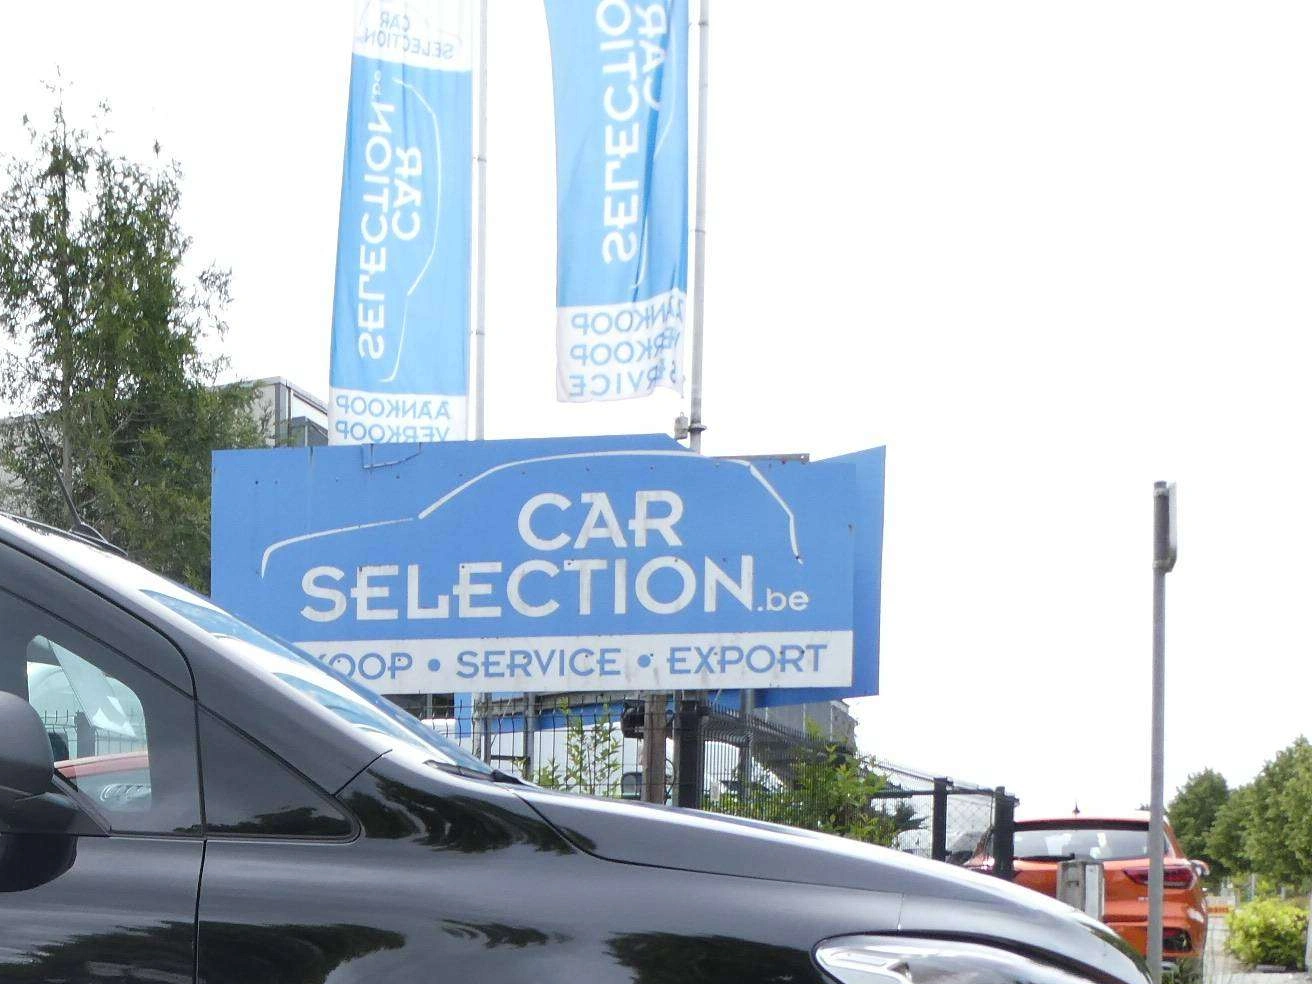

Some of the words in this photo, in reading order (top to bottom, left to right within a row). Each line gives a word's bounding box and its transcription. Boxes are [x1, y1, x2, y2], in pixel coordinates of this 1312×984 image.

[517, 489, 684, 552] CAR
[317, 651, 413, 681] OOP
[456, 647, 622, 679] SERVICE
[666, 644, 829, 675] EXPORT
